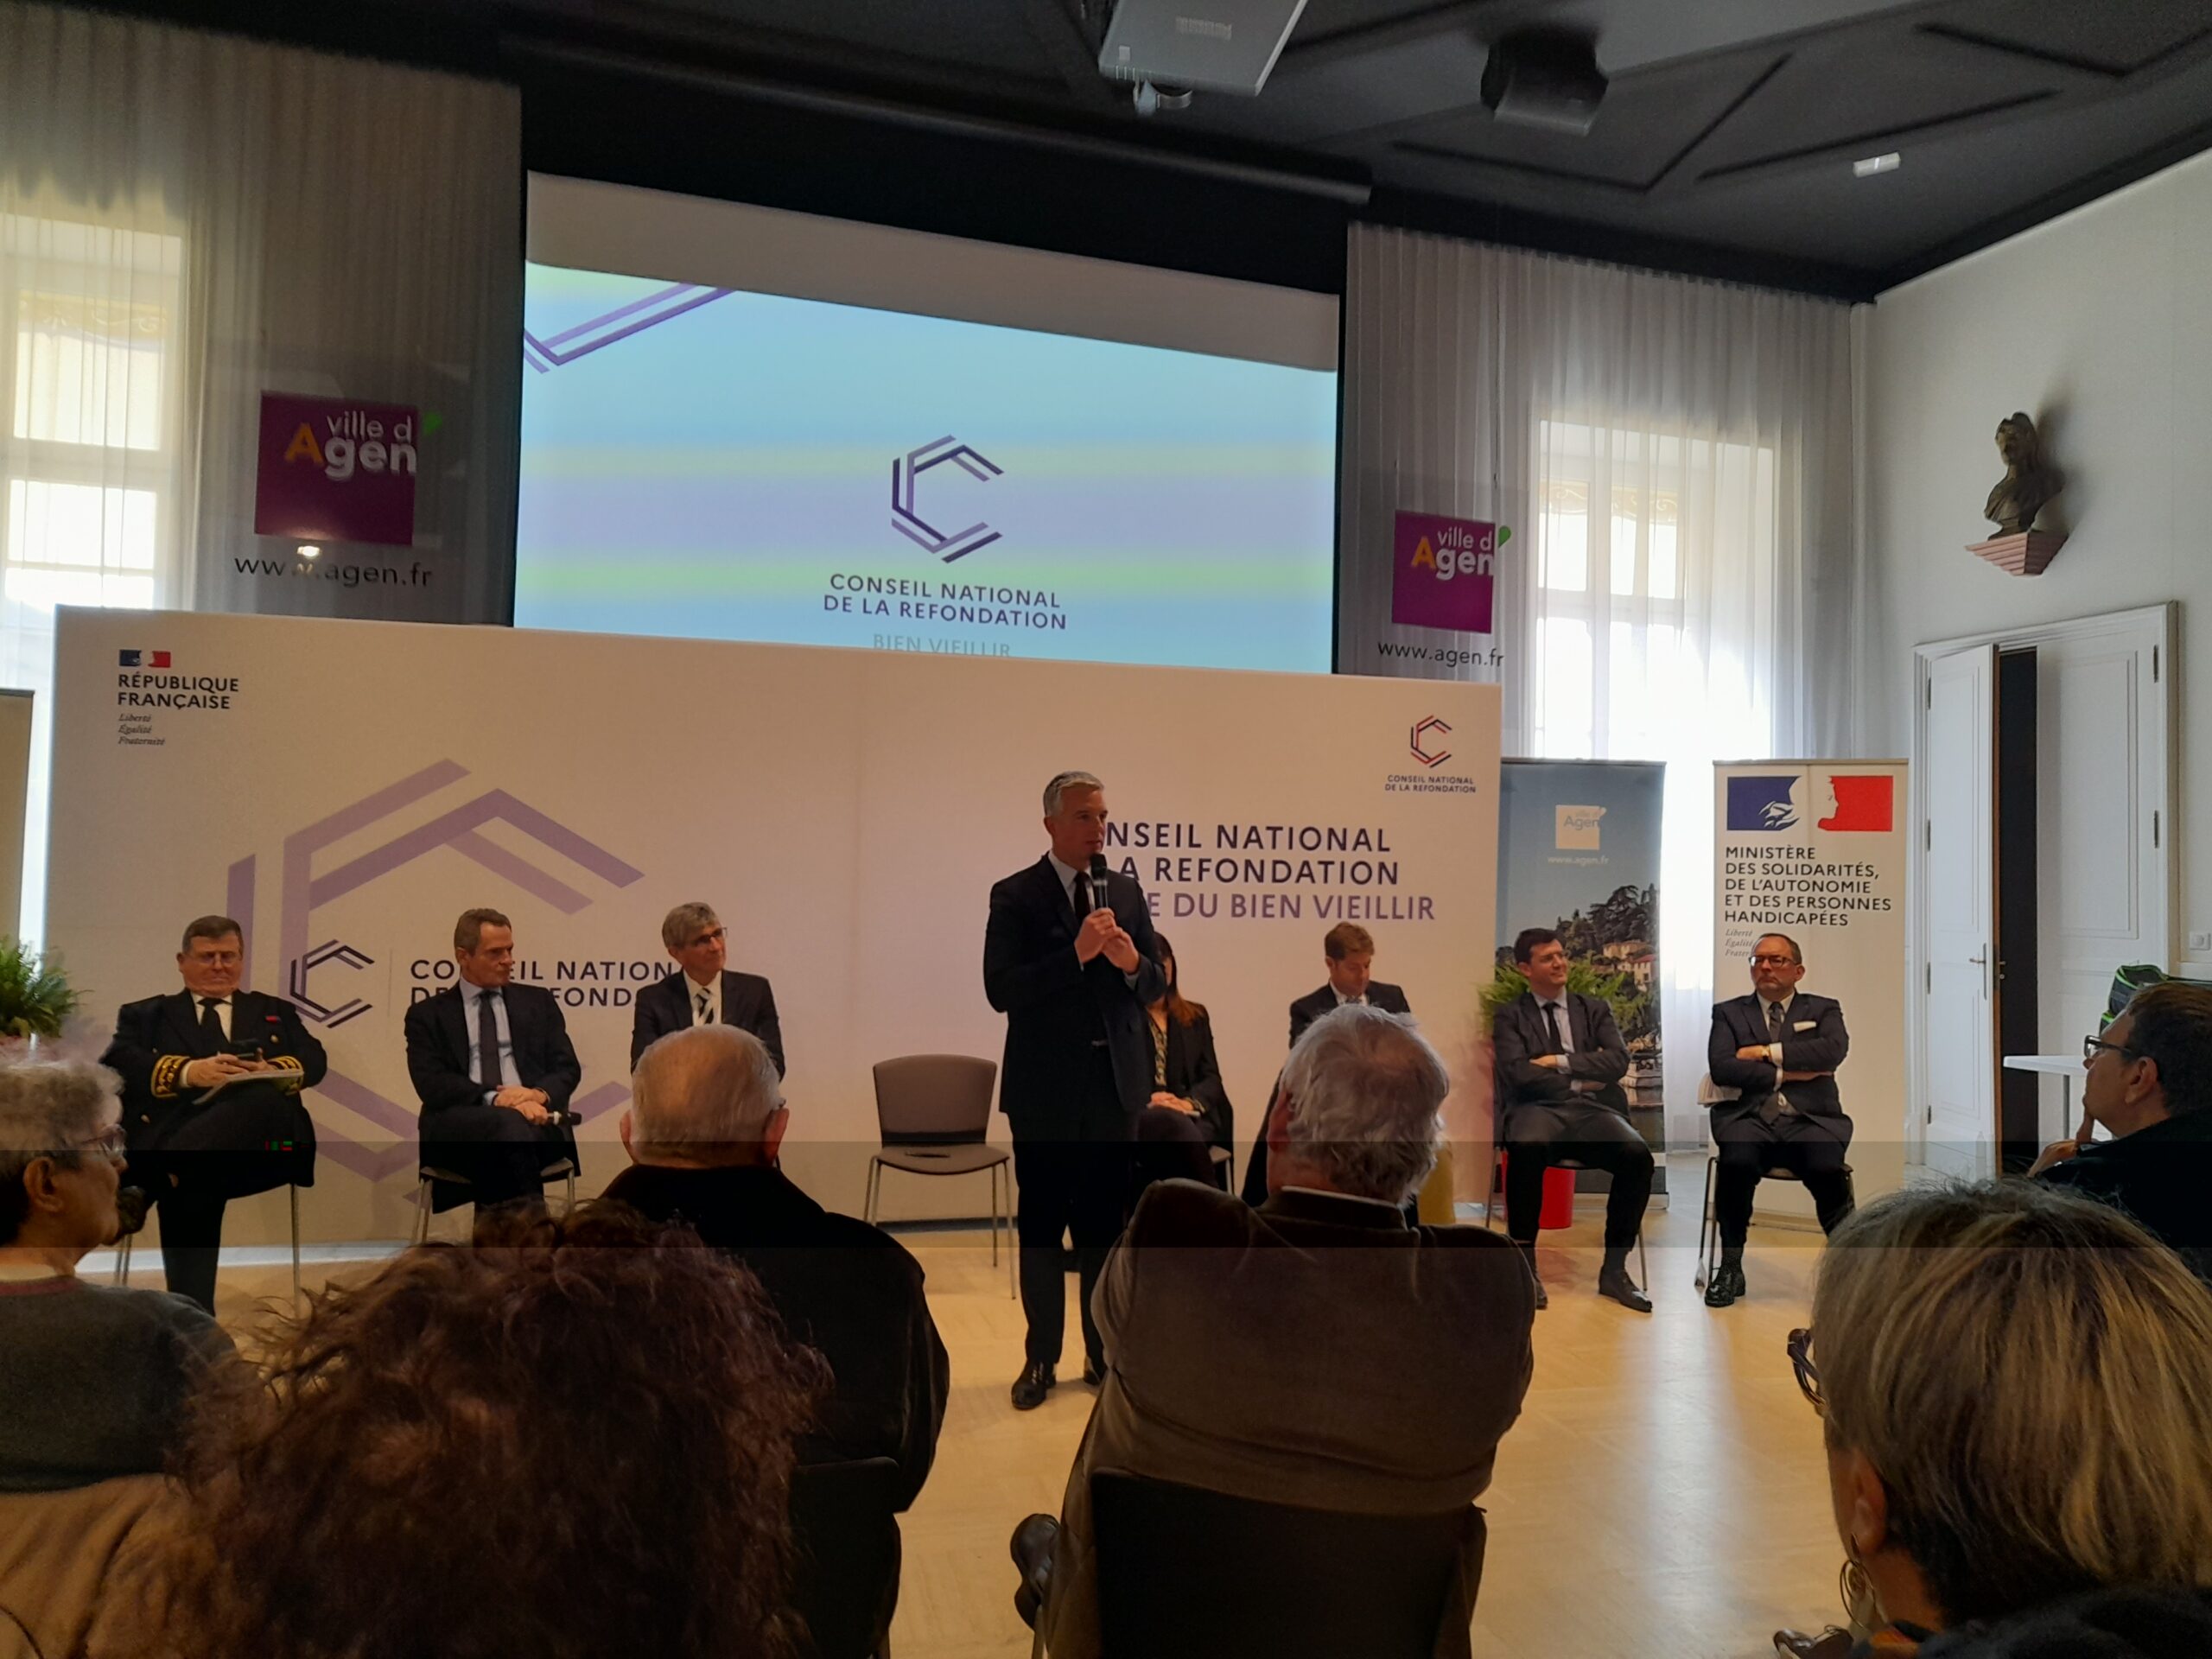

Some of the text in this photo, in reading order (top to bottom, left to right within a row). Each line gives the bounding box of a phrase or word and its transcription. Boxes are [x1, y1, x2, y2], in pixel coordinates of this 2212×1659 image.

[327, 410, 385, 440] ville
[285, 423, 417, 481] Agen
[1437, 526, 1475, 550] ville
[1411, 535, 1495, 581] Agen
[830, 574, 1061, 608] CONSEIL NATIONAL
[823, 594, 1067, 630] DE LA REFONDATION
[1377, 642, 1505, 668] www.agen.fr
[118, 671, 238, 694] RÉPUBLIQUE
[118, 692, 231, 710] FRANÇAISE
[118, 713, 151, 722] Liberté
[118, 724, 152, 735] Égalité
[118, 735, 166, 746] Fraternité
[1387, 774, 1474, 785] CONSEIL NATIONAL
[1413, 785, 1477, 793] REFONDATION
[1563, 815, 1600, 830] Agen
[1106, 822, 1391, 853] NSEIL NATIONAL
[1726, 844, 1816, 860] MINISTÈRE
[1154, 857, 1399, 886] REFONDATION
[1726, 861, 1879, 880] DES SOLIDARITÉS,
[1726, 879, 1872, 893] DE L'AUTONOMIE
[1173, 893, 1217, 918] DU
[1230, 893, 1301, 918] BIEN
[1313, 895, 1436, 920] VIEILLIR
[1725, 894, 1891, 911] ET DES PERSONNES
[1725, 910, 1849, 926] HANDICAPÉES
[1725, 928, 1753, 937] Liberté
[556, 961, 673, 981] NATION
